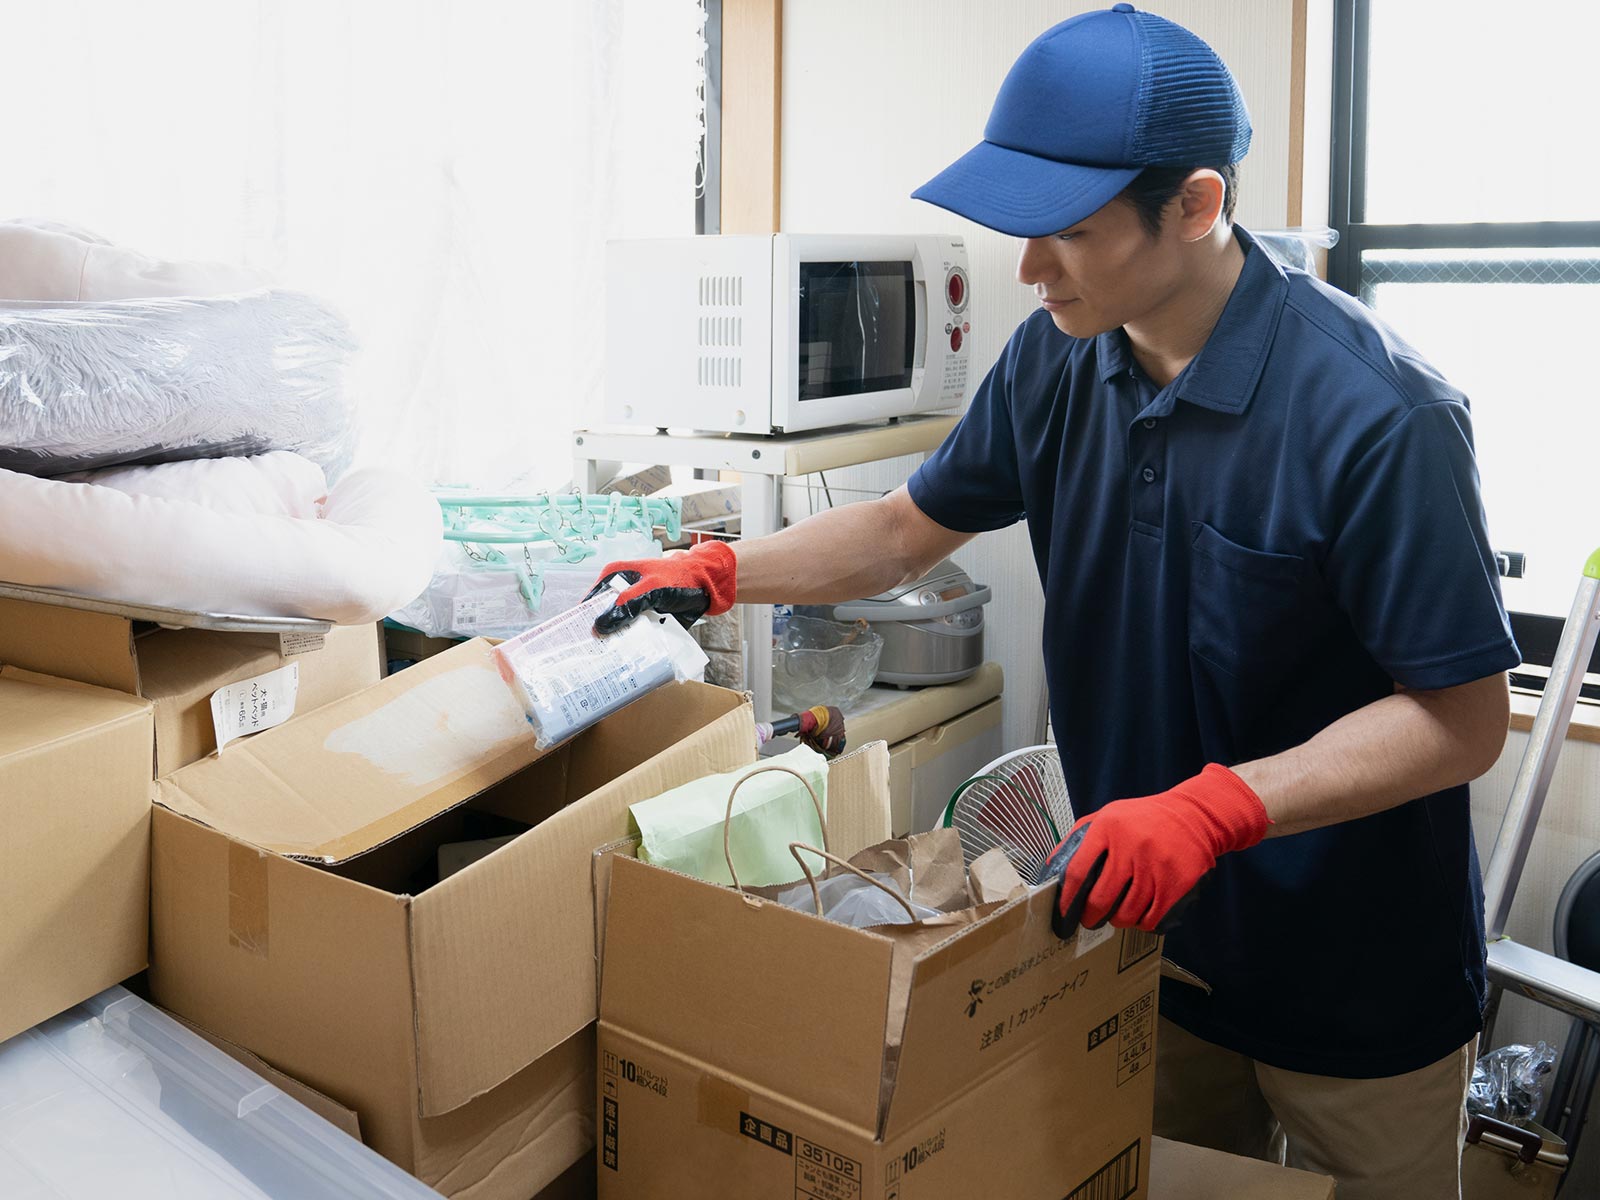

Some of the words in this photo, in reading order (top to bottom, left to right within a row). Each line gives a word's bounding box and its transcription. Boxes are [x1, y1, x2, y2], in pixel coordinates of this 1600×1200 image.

[1123, 996, 1150, 1022] 35102
[743, 1116, 789, 1151] 企画品
[803, 1143, 855, 1177] 35102
